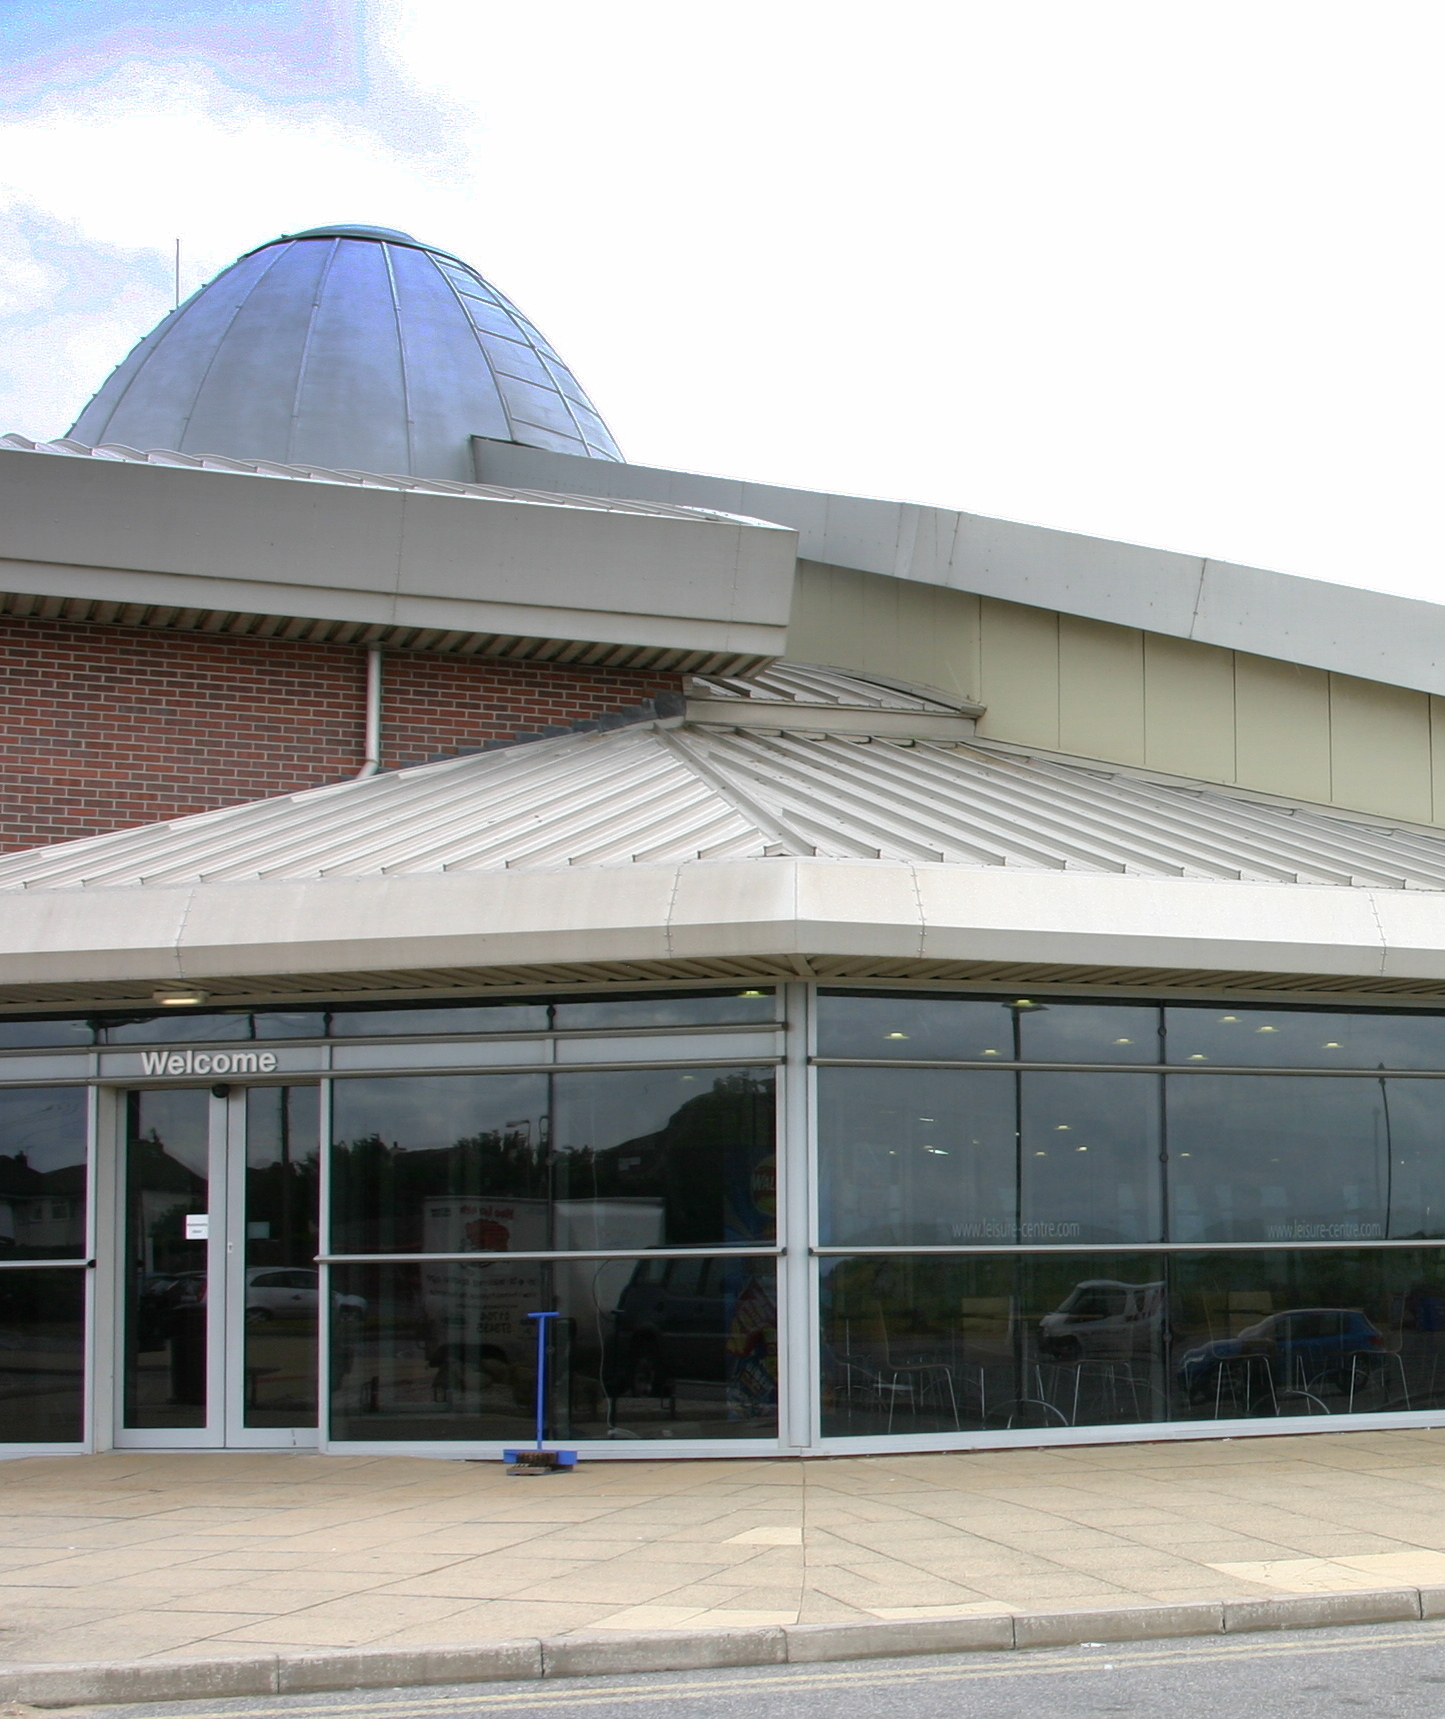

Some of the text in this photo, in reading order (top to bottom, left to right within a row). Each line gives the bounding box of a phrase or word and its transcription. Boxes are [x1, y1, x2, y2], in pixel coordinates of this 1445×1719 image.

[141, 1050, 277, 1075] Welcome
[952, 1217, 1080, 1238] www.leisure-centre.com
[1267, 1218, 1381, 1238] www.leisure-centre.com
